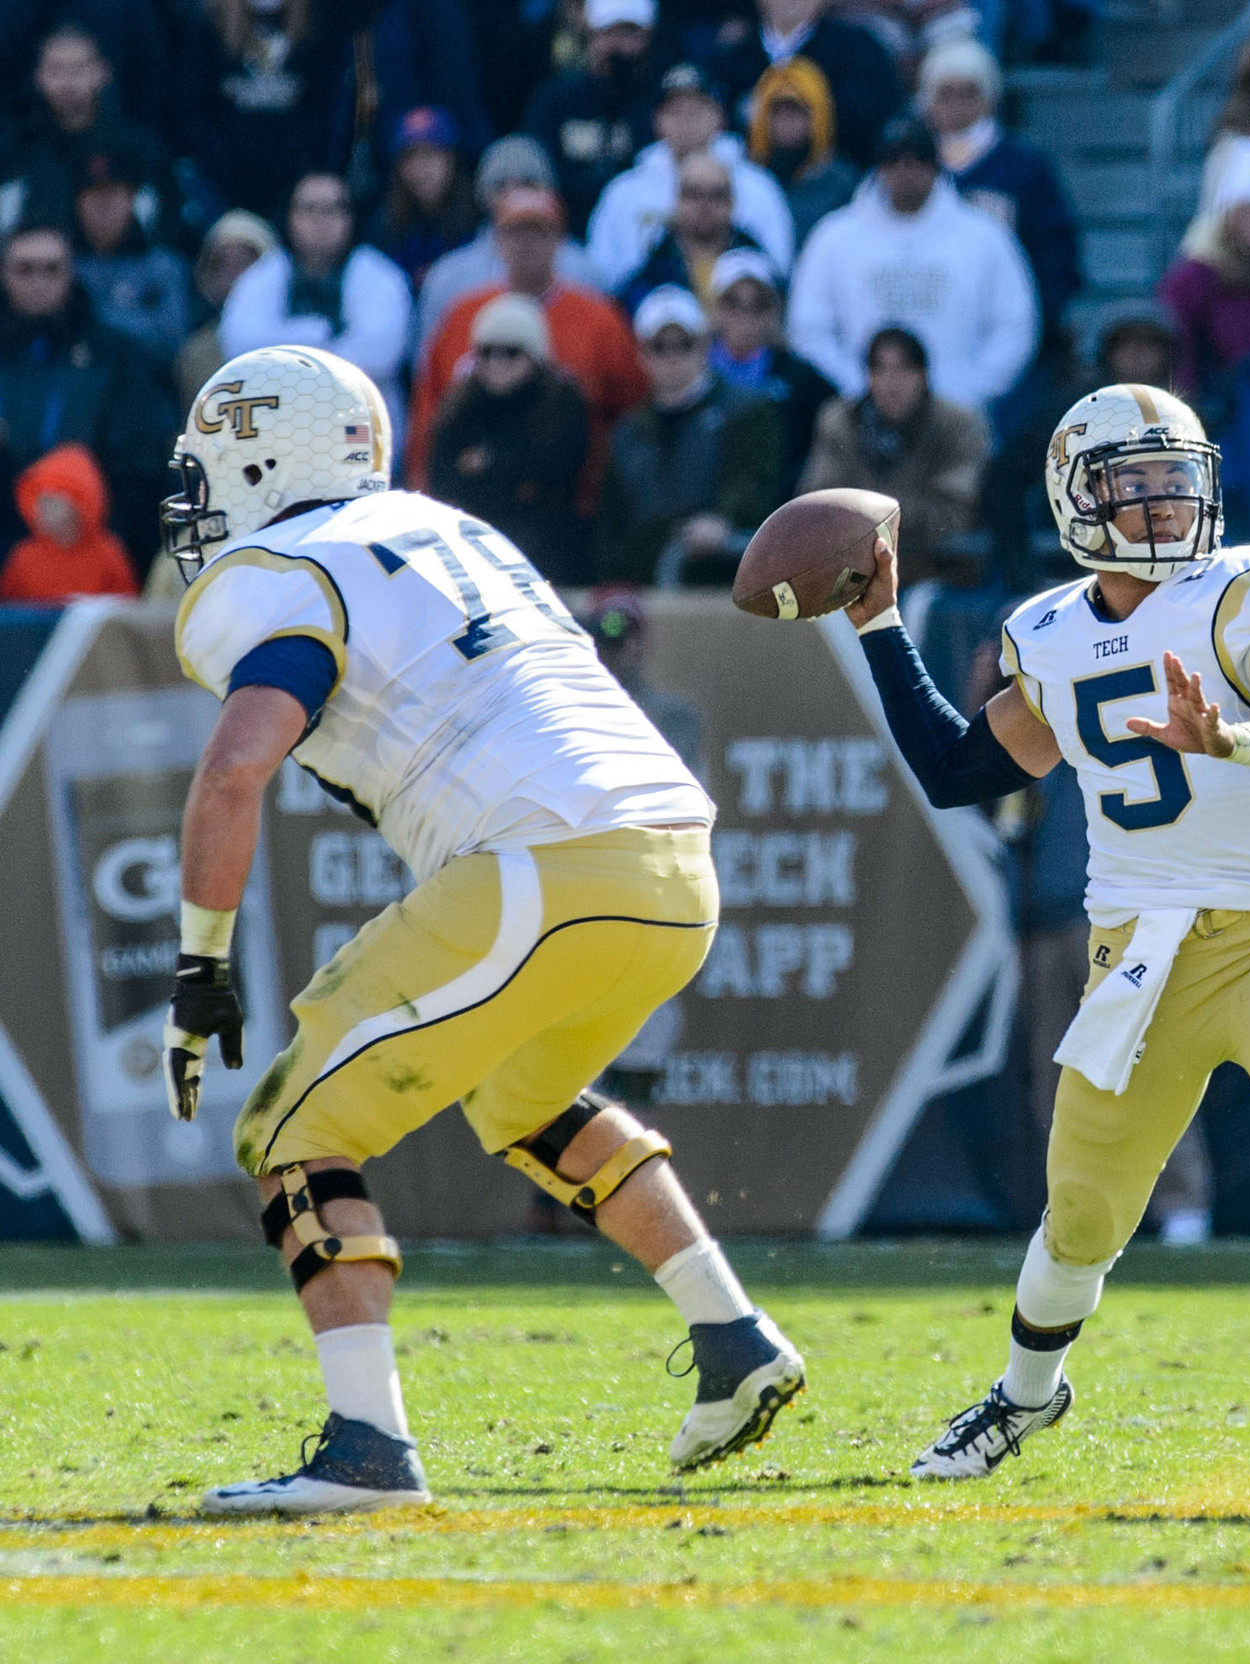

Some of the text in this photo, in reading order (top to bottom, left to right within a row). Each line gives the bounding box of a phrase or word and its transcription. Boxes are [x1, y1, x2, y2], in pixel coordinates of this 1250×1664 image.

[194, 379, 279, 440] GT
[1144, 427, 1170, 437] ACC
[344, 451, 369, 462] ACC
[1092, 635, 1129, 659] TECH
[728, 737, 890, 815] THE
[1071, 660, 1197, 834] 5
[703, 923, 853, 998] APP
